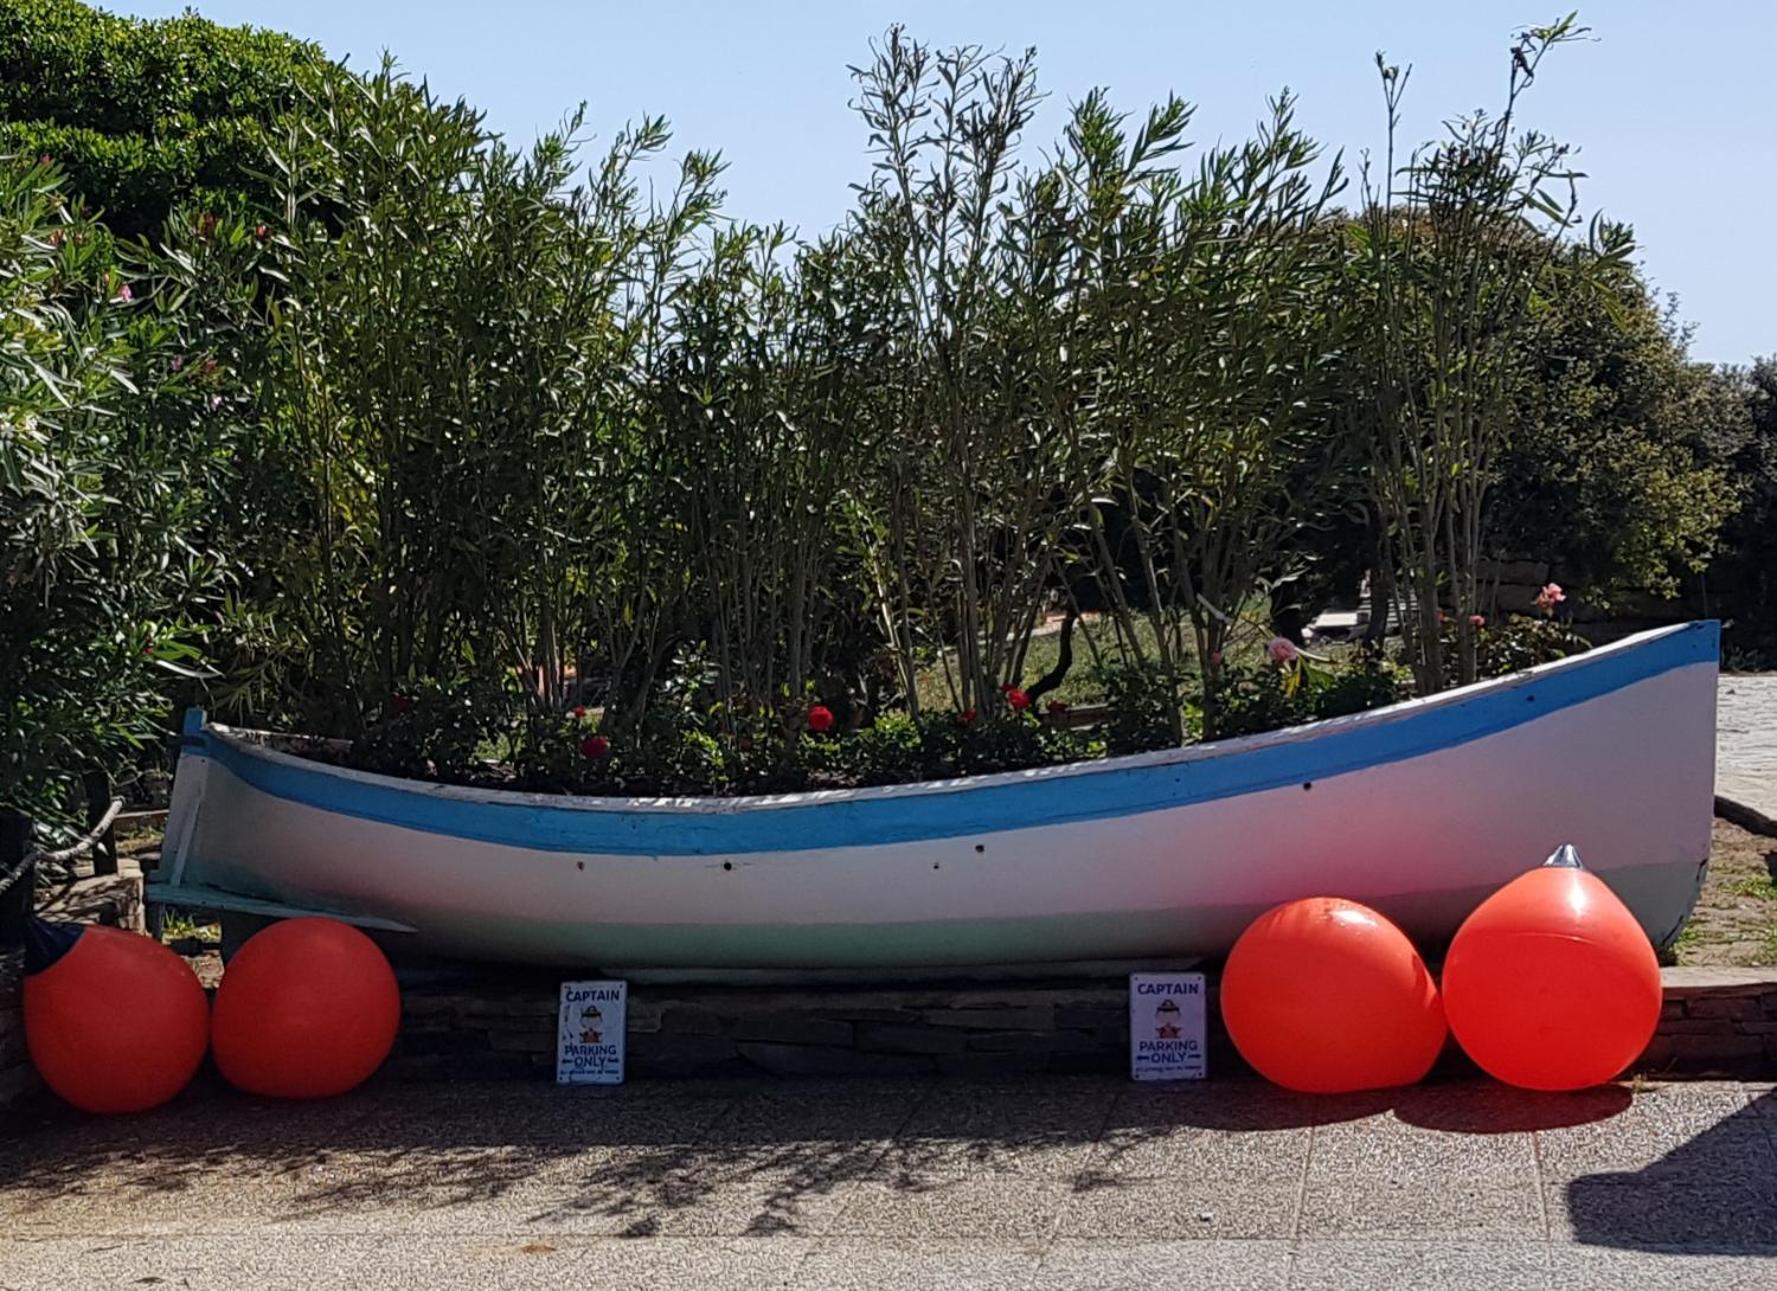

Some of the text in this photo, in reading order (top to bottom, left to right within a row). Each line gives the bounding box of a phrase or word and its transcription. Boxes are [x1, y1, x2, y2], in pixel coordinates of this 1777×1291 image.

[1137, 983, 1199, 995] CAPTAIN
[566, 990, 620, 1002] CAPTAIN
[564, 1045, 617, 1056] PARKING
[1139, 1040, 1198, 1051] PARKING
[574, 1056, 606, 1068] ONLY
[1150, 1052, 1187, 1063] ONLY
